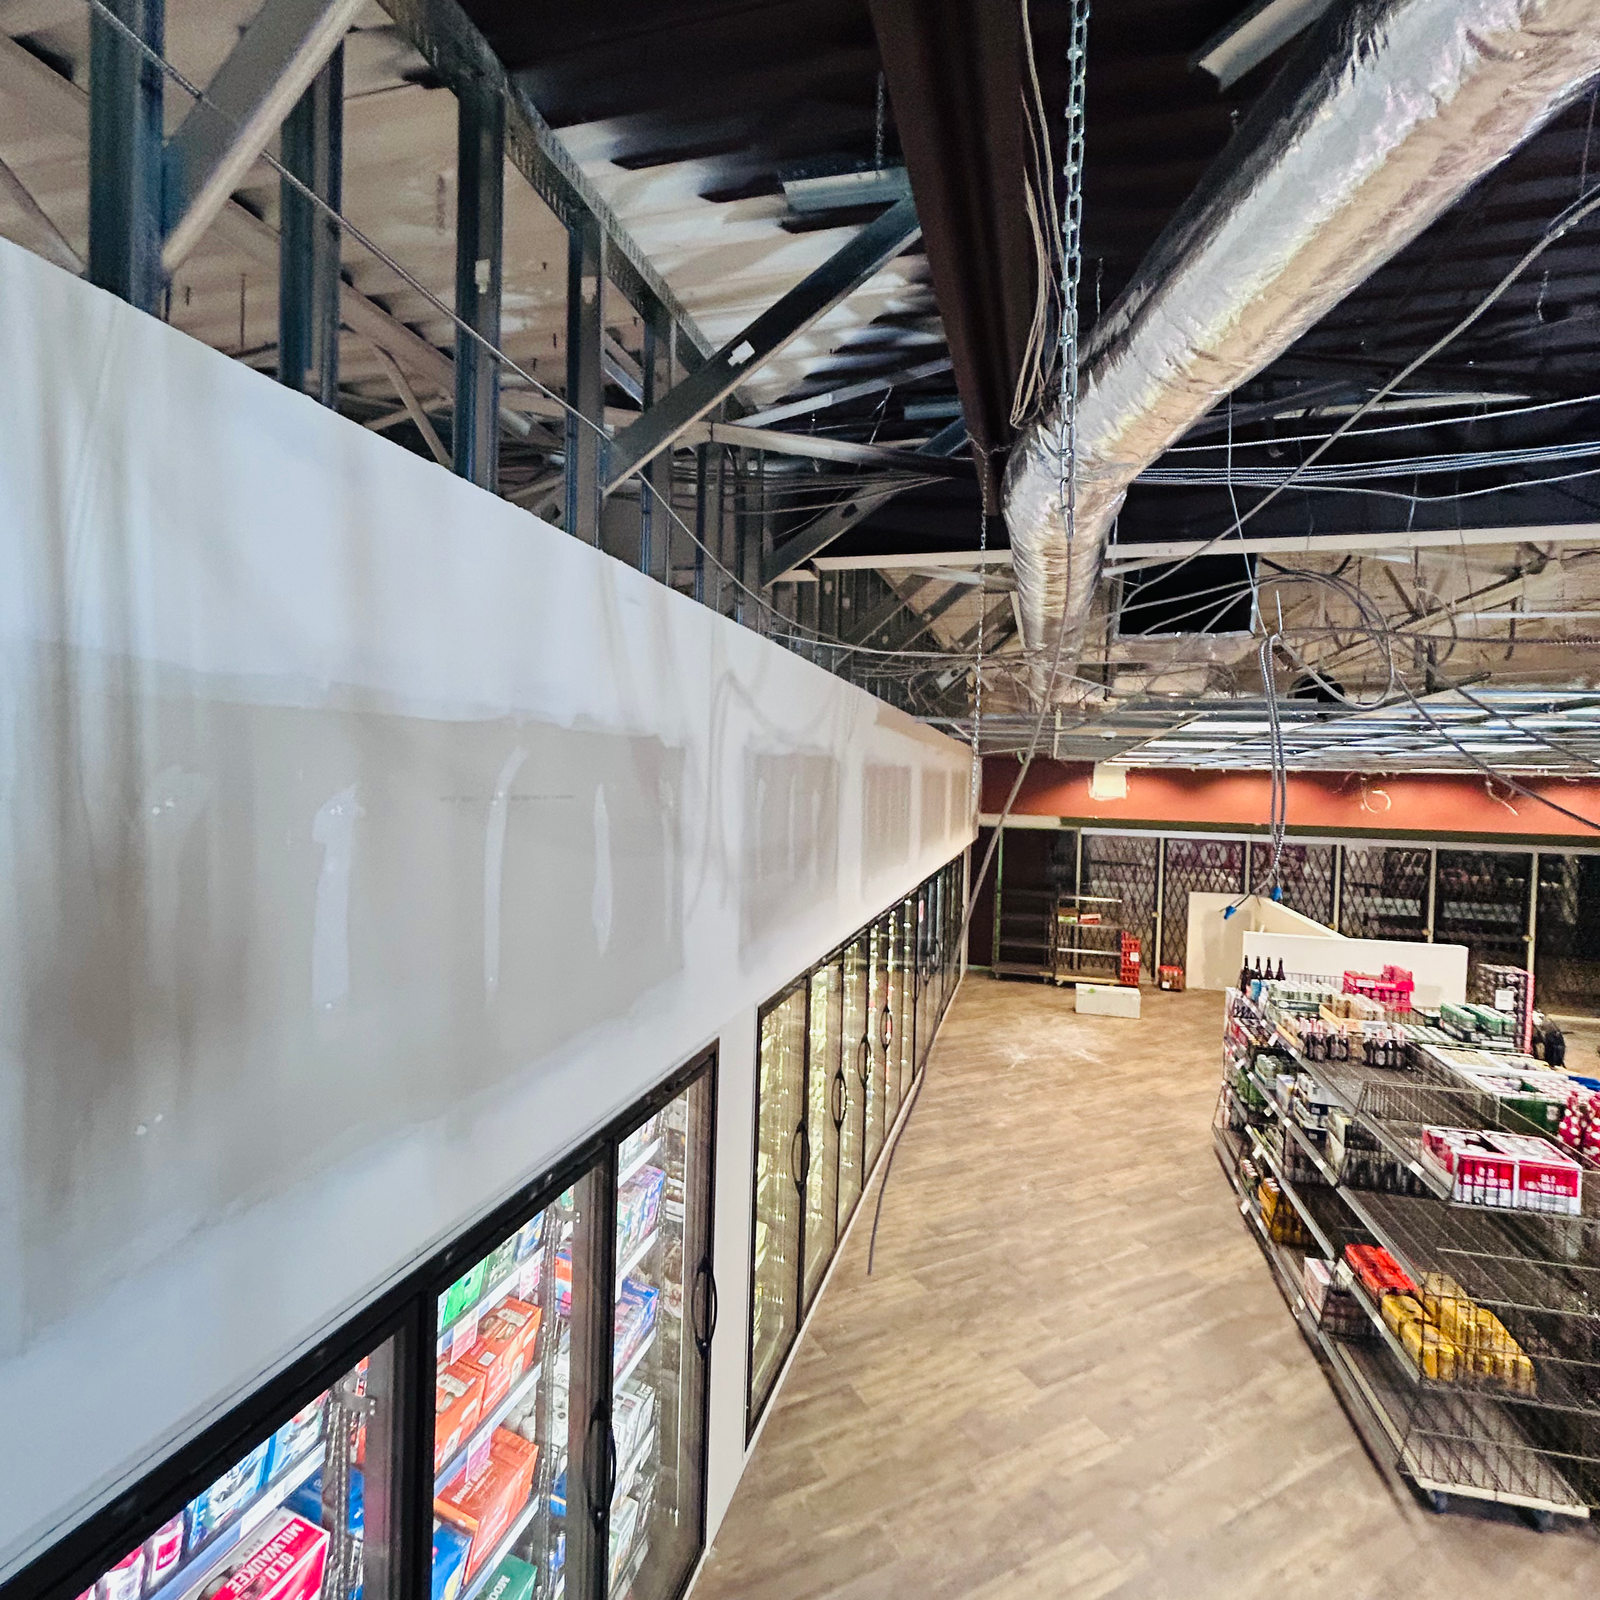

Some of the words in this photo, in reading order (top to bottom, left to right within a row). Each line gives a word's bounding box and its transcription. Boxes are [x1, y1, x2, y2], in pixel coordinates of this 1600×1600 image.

[639, 1383, 653, 1396] 15
[451, 1480, 474, 1505] HONEY
[226, 1522, 305, 1594] MILWAUKEE
[264, 1552, 295, 1581] OLD
